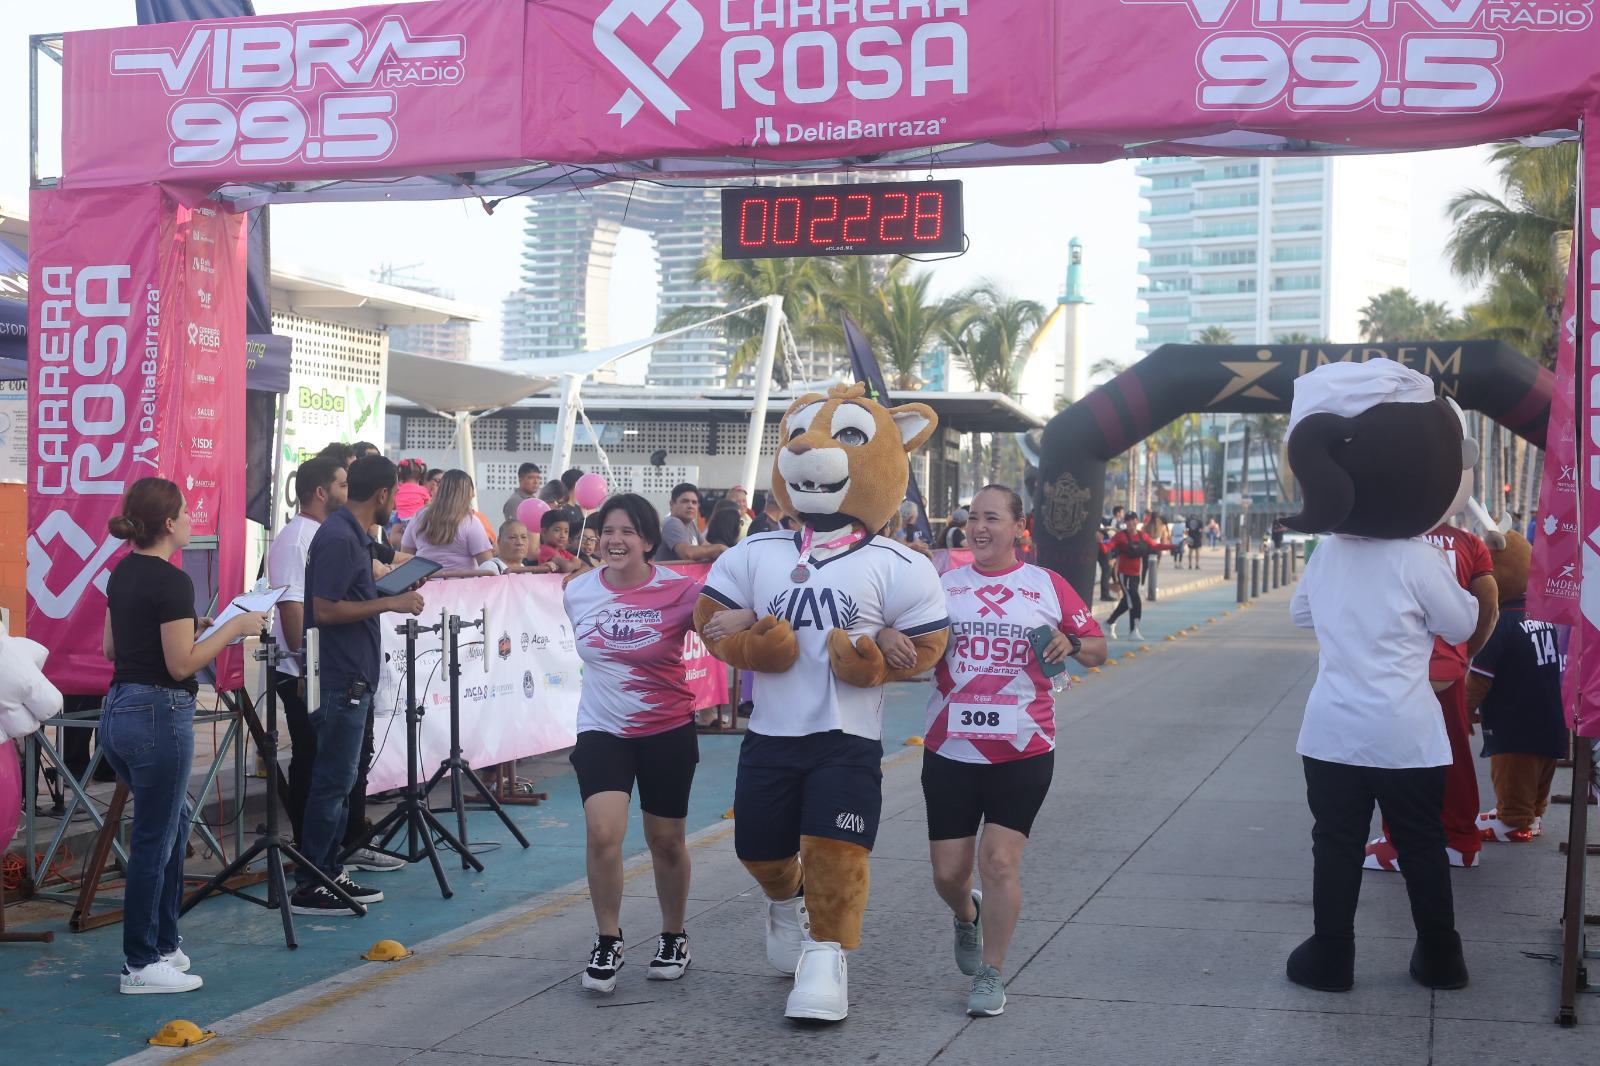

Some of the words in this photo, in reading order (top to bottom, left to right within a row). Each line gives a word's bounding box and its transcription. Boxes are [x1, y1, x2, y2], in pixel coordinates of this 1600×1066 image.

[1490, 8, 1586, 25] RADIO
[113, 20, 462, 90] VIBRA
[720, 22, 969, 109] ROSA
[386, 66, 459, 81] RADIO
[1202, 36, 1499, 107] 99.5
[171, 95, 394, 162] 99.5
[199, 334, 220, 348] ROSA
[37, 266, 72, 495] CARRERA
[70, 264, 131, 495] ROSA
[197, 407, 215, 416] SALUD
[299, 386, 345, 413] Boba
[1547, 577, 1580, 592] IMDEM
[952, 636, 1030, 664] ROSA
[961, 710, 1000, 727] 308
